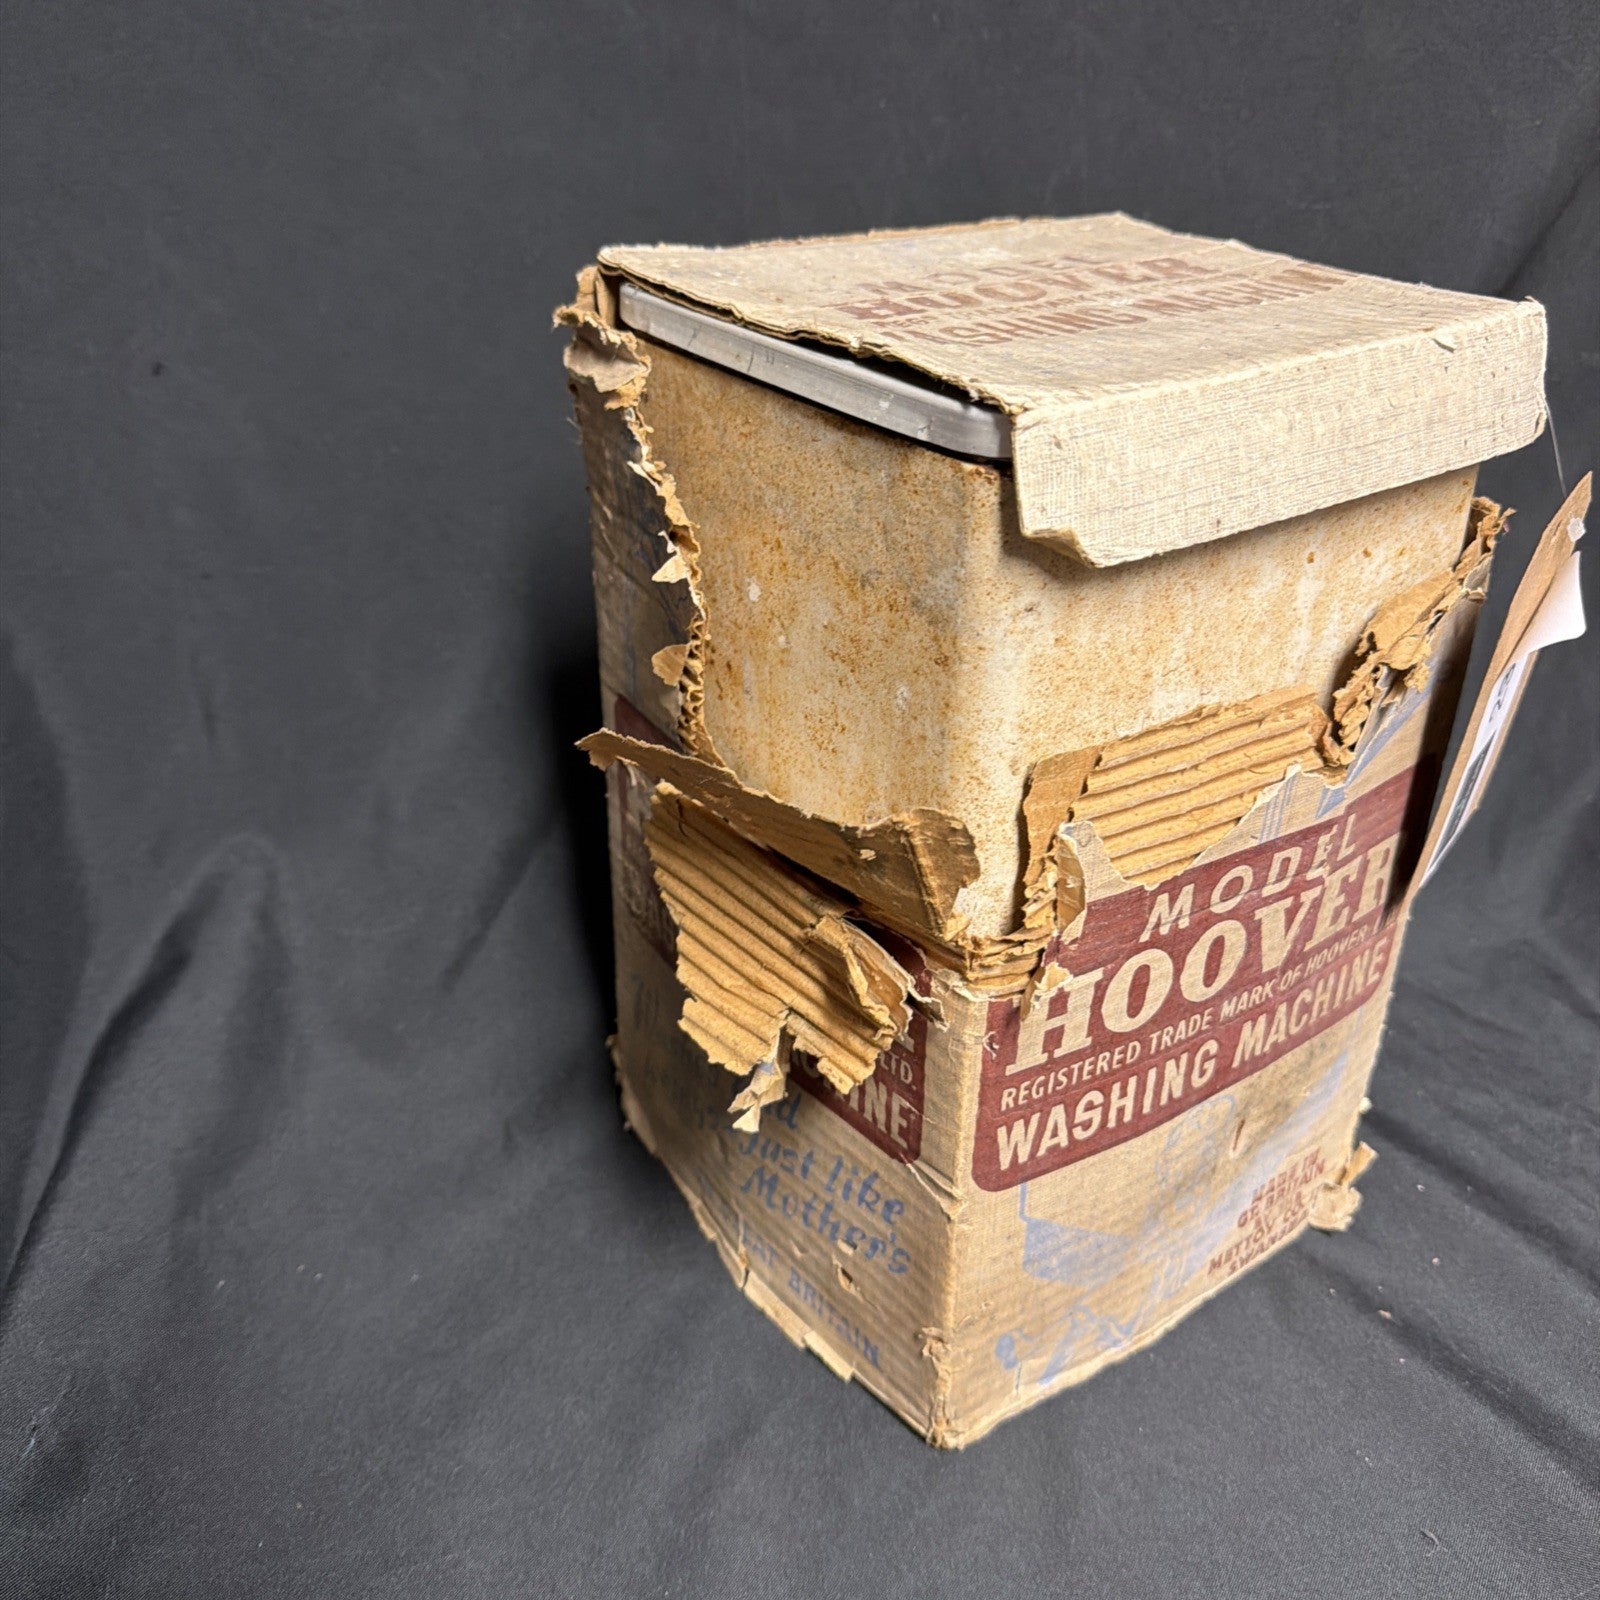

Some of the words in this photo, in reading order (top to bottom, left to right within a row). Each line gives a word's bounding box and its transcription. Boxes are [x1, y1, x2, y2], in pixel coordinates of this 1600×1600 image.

[832, 257, 1222, 320] HOOVER
[857, 255, 1116, 294] MODEL
[1139, 813, 1356, 943] MODEL
[1005, 832, 1400, 1076] HOOVER
[997, 1039, 1218, 1171] WASHING
[1231, 937, 1388, 1069] MACHINE
[1001, 1040, 1142, 1112] REGISTERED
[1150, 1007, 1213, 1055] TRADE
[1219, 978, 1277, 1022] MARK
[1279, 964, 1304, 992] OF
[1303, 924, 1368, 978] HOOVER
[740, 1165, 911, 1275] Mother's
[824, 1154, 905, 1225] like
